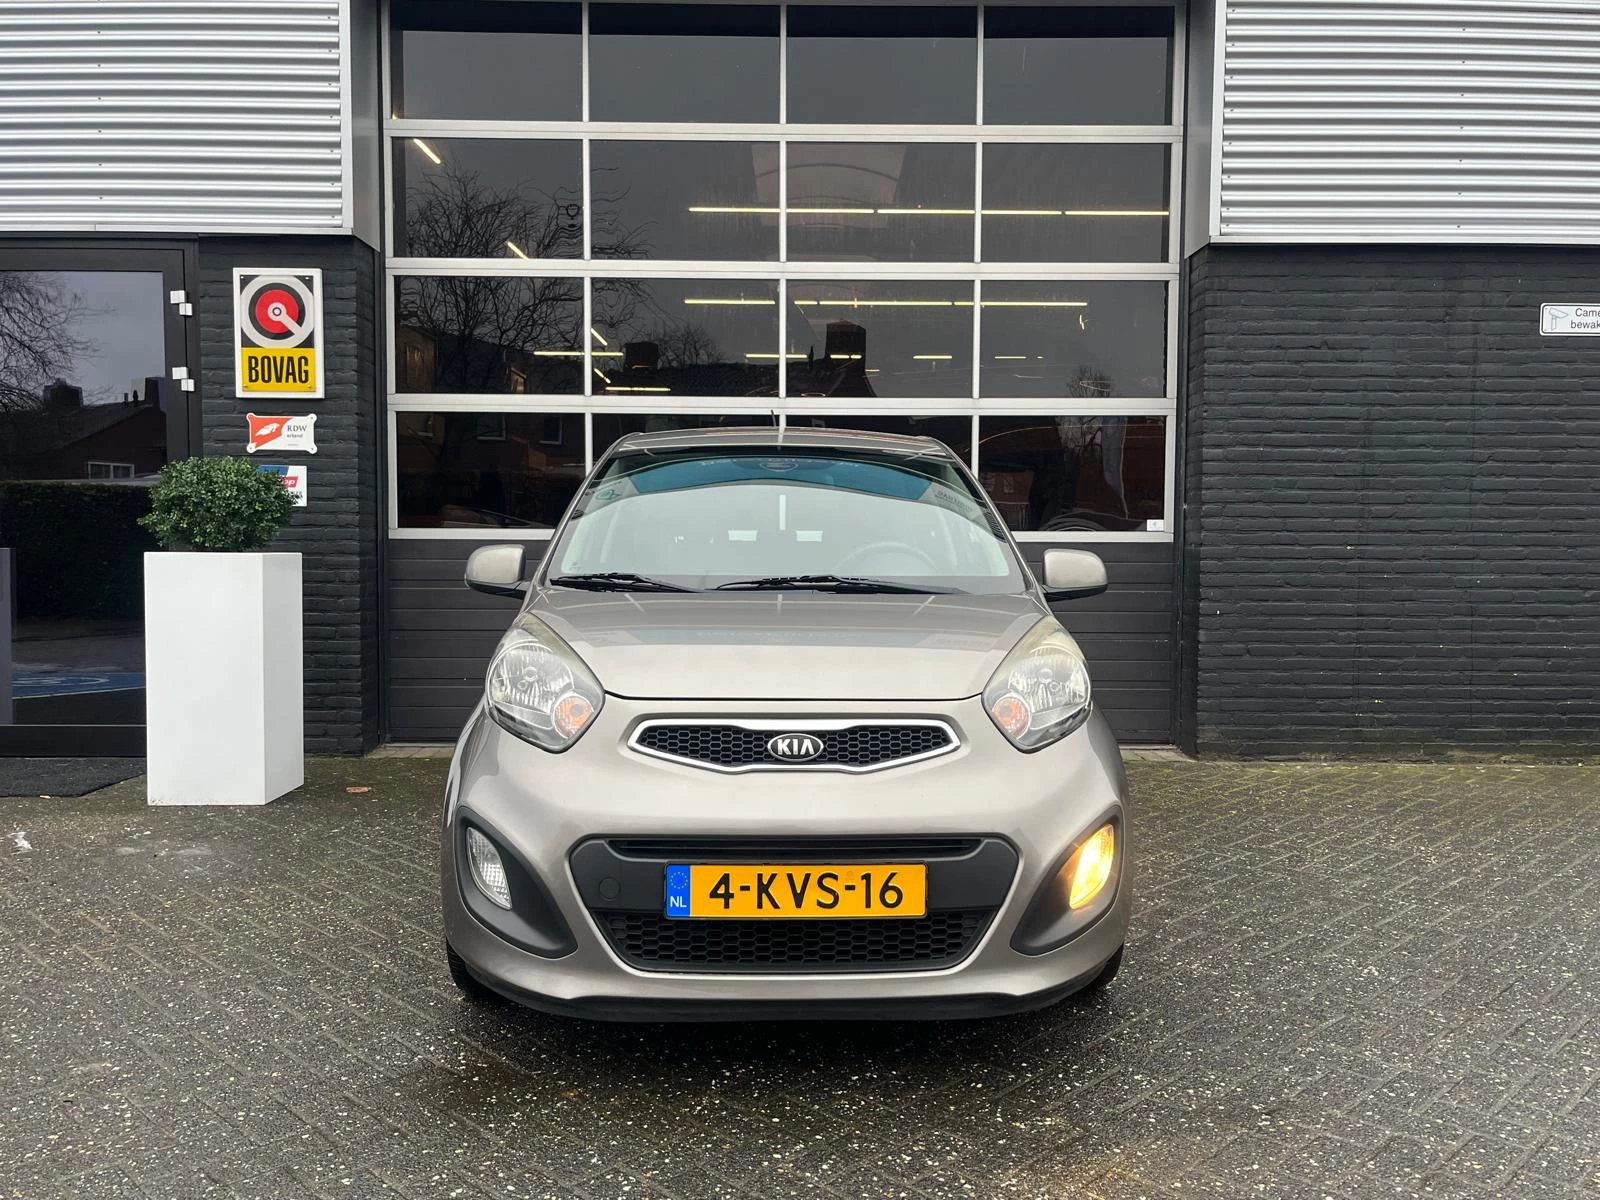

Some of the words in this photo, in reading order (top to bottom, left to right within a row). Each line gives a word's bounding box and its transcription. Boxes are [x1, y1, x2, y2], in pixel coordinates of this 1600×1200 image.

[248, 355, 309, 384] BOVAG
[287, 424, 308, 432] RDW
[777, 738, 815, 755] KIA
[709, 872, 904, 909] 4-KVS-16
[670, 895, 688, 908] NL
